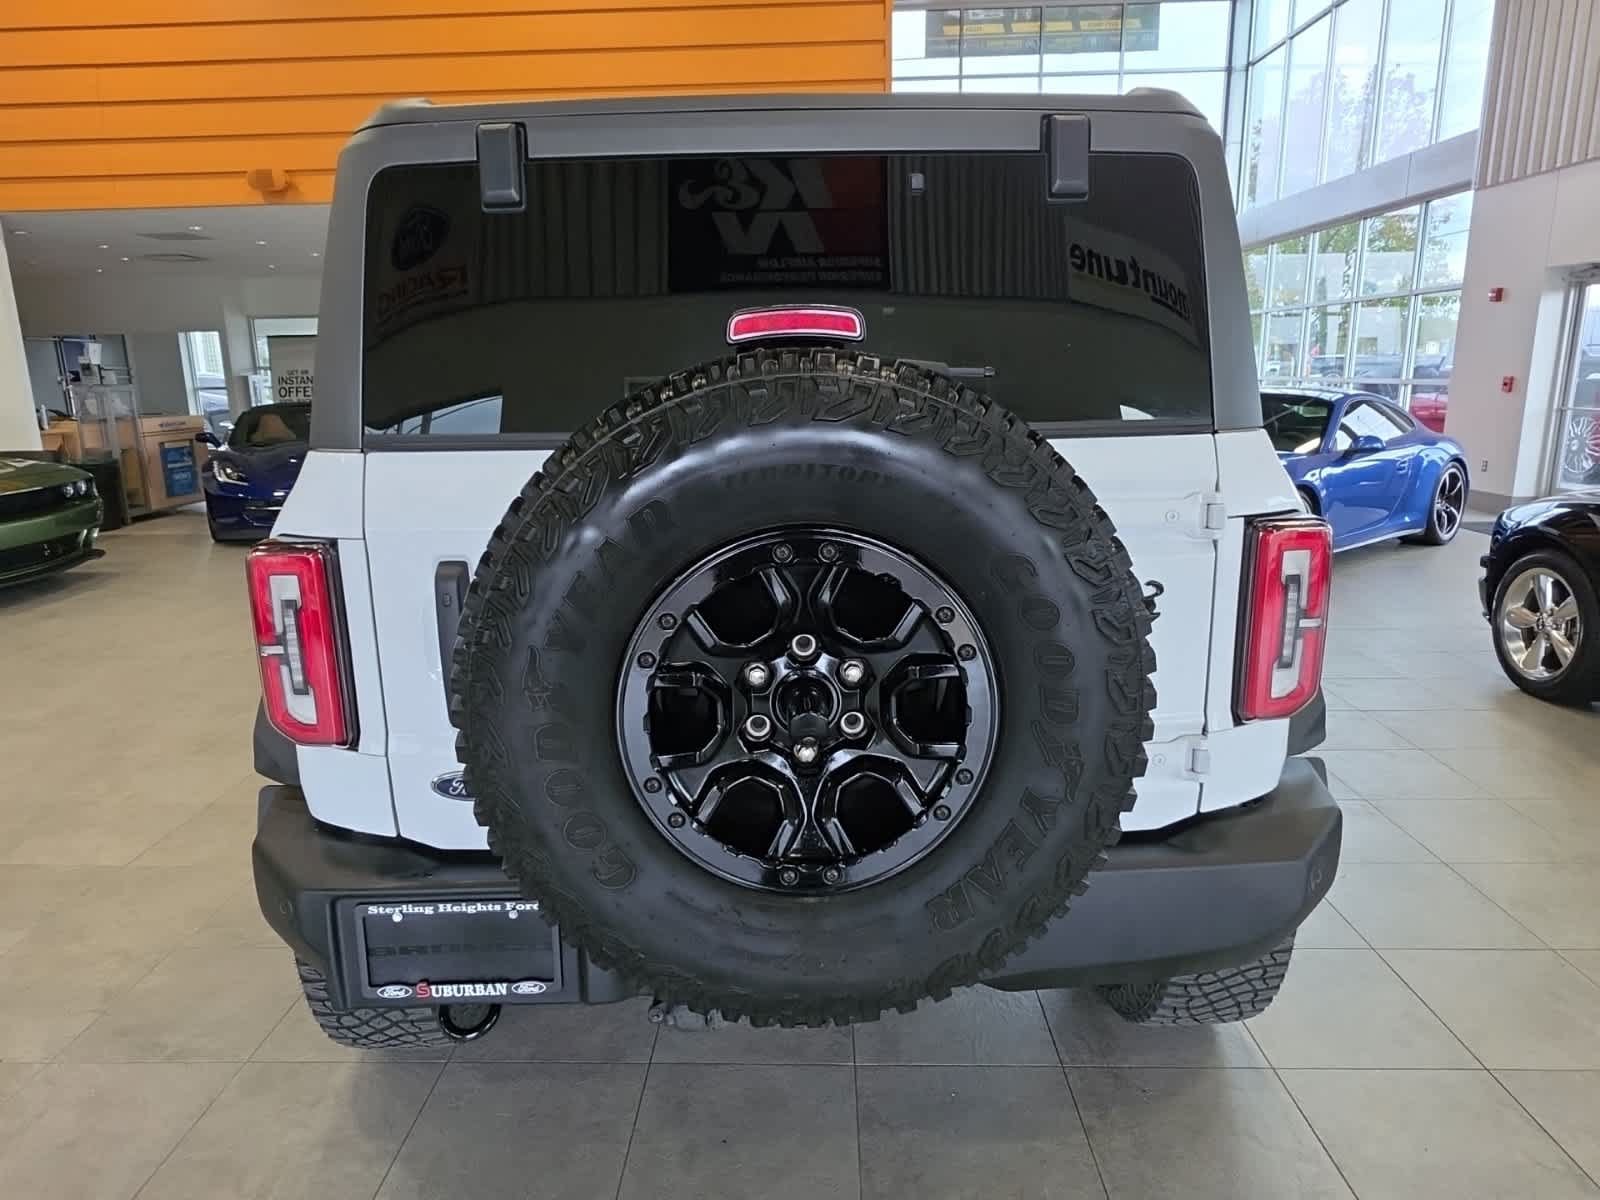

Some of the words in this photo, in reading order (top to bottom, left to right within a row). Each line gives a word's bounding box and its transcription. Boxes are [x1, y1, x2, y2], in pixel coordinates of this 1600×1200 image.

[278, 375, 314, 385] INSTAN
[279, 386, 313, 398] OFFE
[924, 552, 1086, 934] GOODYEAR
[367, 904, 434, 915] Sterling
[438, 902, 502, 914] Heights
[415, 981, 508, 998] SUBURBAN
